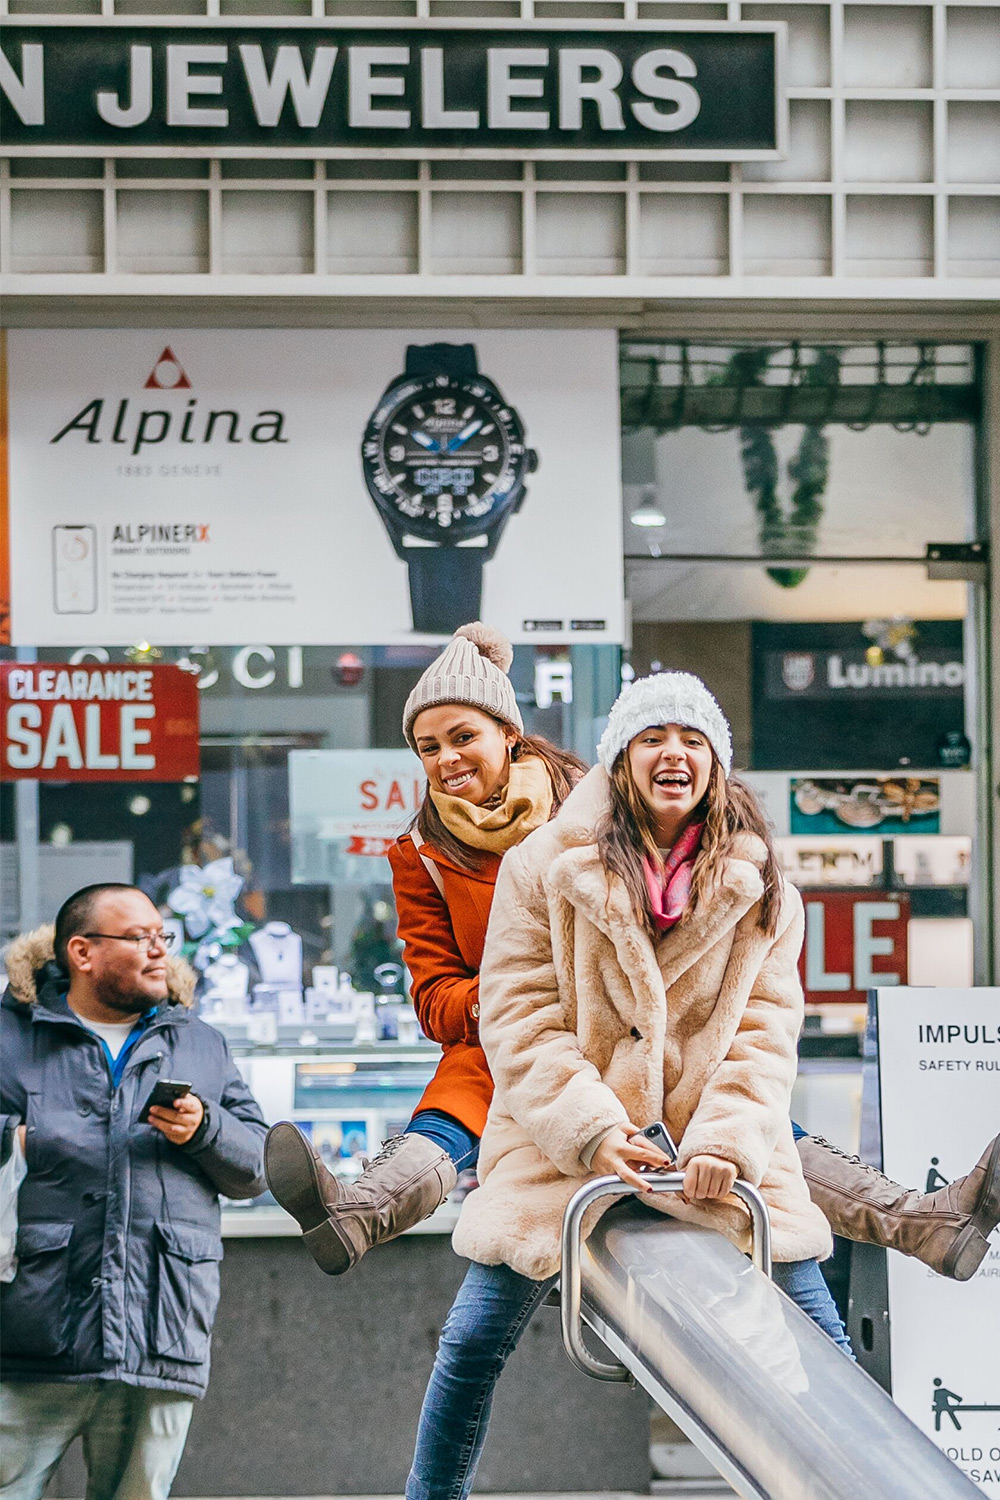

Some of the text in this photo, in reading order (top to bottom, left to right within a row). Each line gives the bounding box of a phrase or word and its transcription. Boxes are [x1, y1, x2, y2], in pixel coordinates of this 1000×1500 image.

[97, 44, 700, 132] JEWELERS
[50, 398, 288, 455] Alpina
[112, 524, 210, 543] ALPINERX
[8, 669, 154, 700] CLEARANCE
[6, 703, 156, 769] SALE
[805, 901, 899, 991] LE
[918, 1060, 971, 1071] SAFETY
[941, 1447, 983, 1462] OLD
